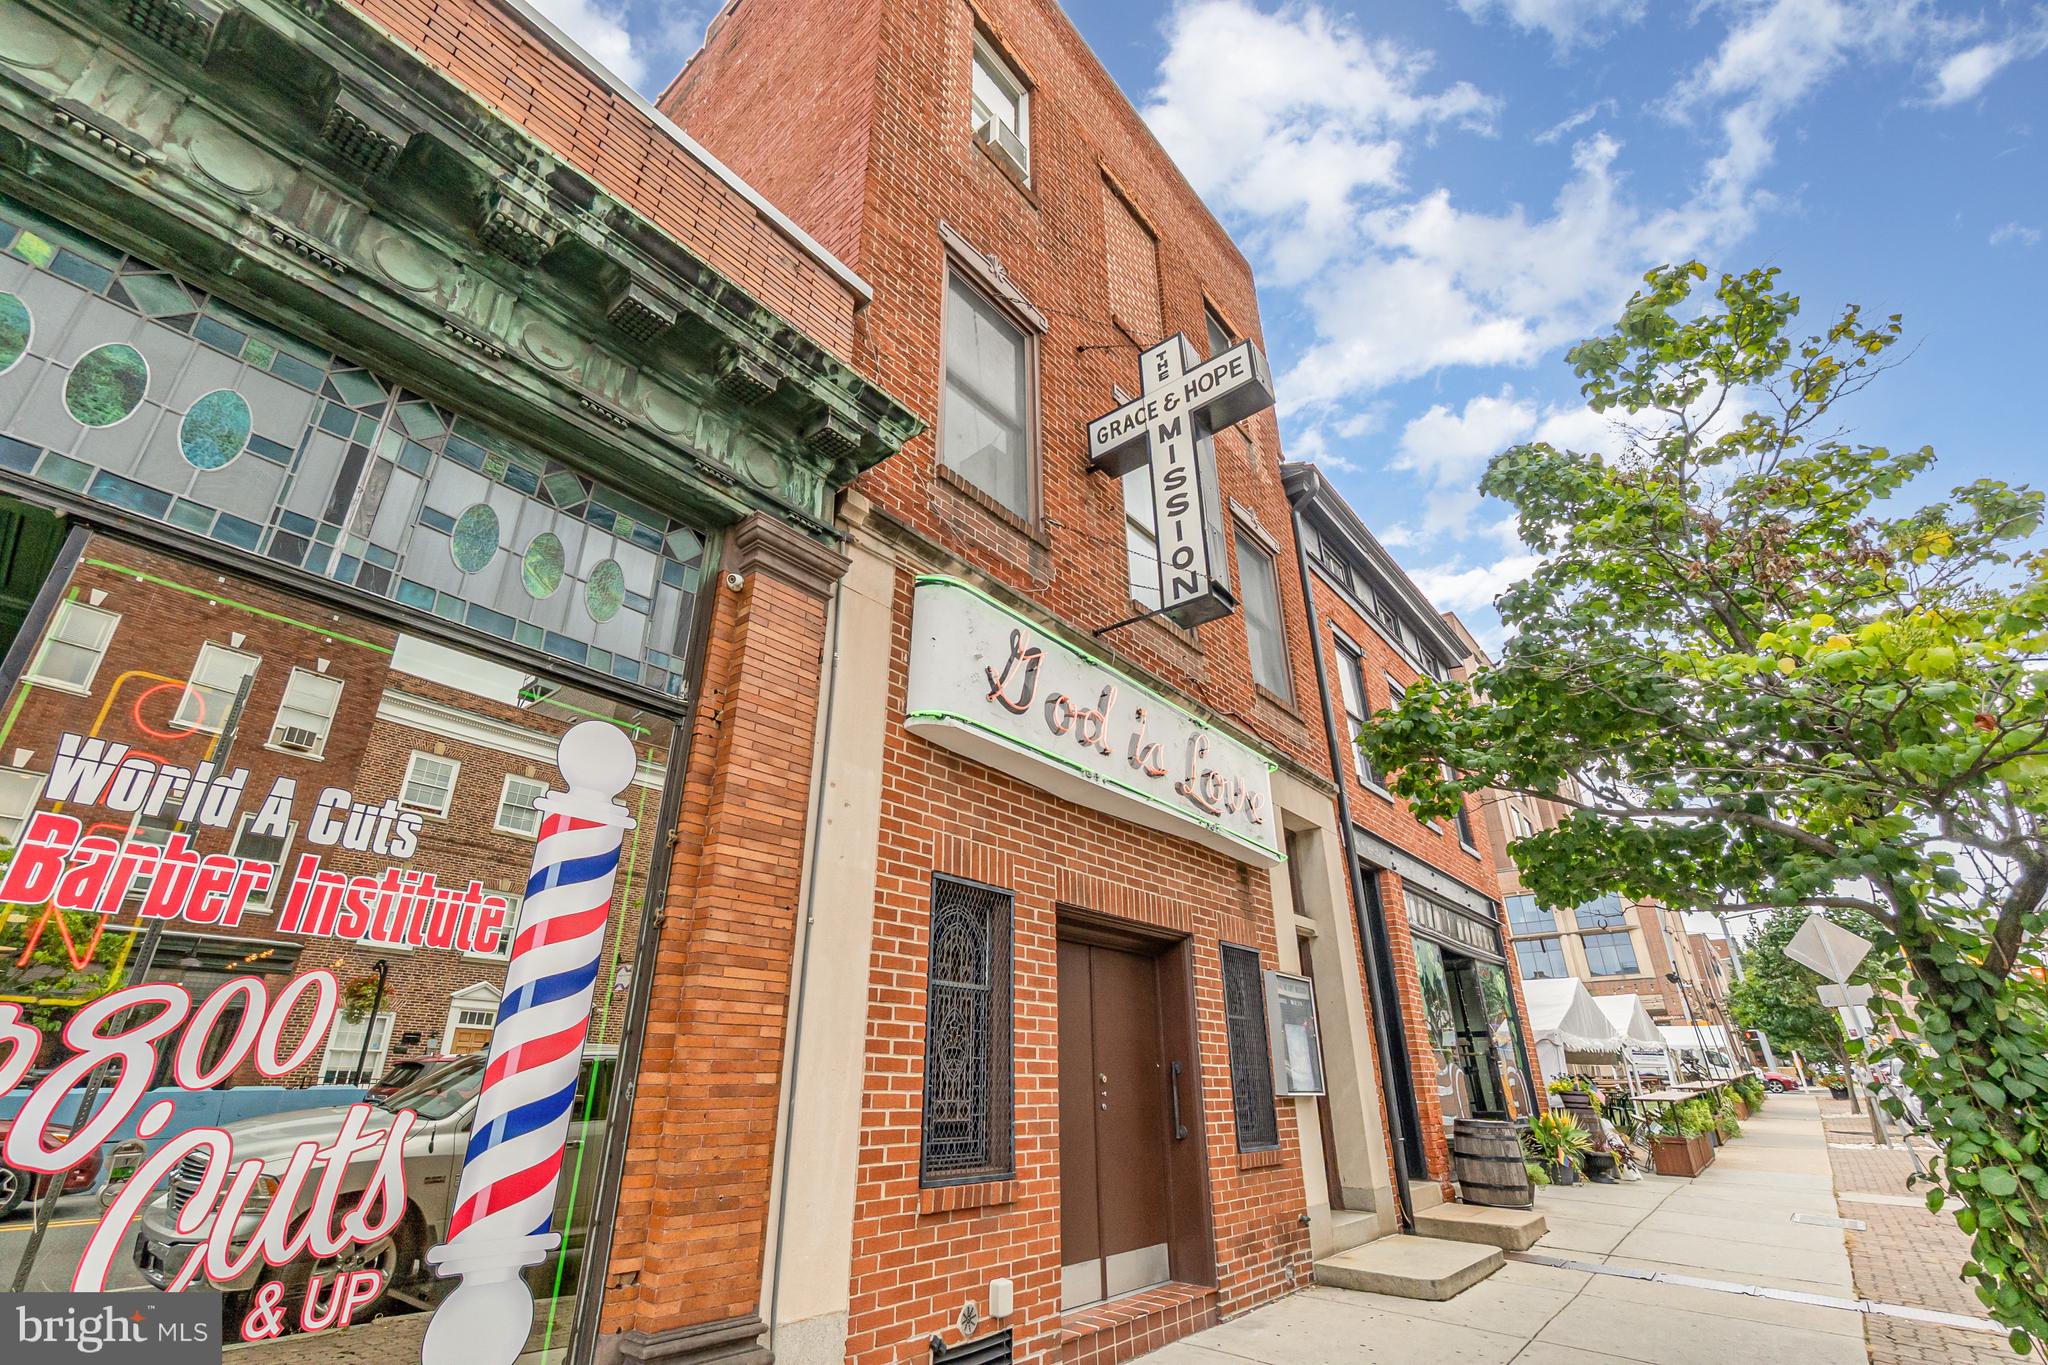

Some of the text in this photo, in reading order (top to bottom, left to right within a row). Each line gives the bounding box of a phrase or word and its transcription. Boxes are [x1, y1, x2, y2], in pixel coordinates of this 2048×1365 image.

[1097, 356, 1244, 445] GRACE & HOPE
[1156, 350, 1170, 382] THE
[1159, 416, 1199, 600] MISSION
[986, 628, 1265, 825] God is Love
[45, 731, 424, 860] World A Cuts
[0, 810, 508, 955] Barber Institute
[72, 1103, 417, 1292] Cuts
[241, 1269, 382, 1342] & UP
